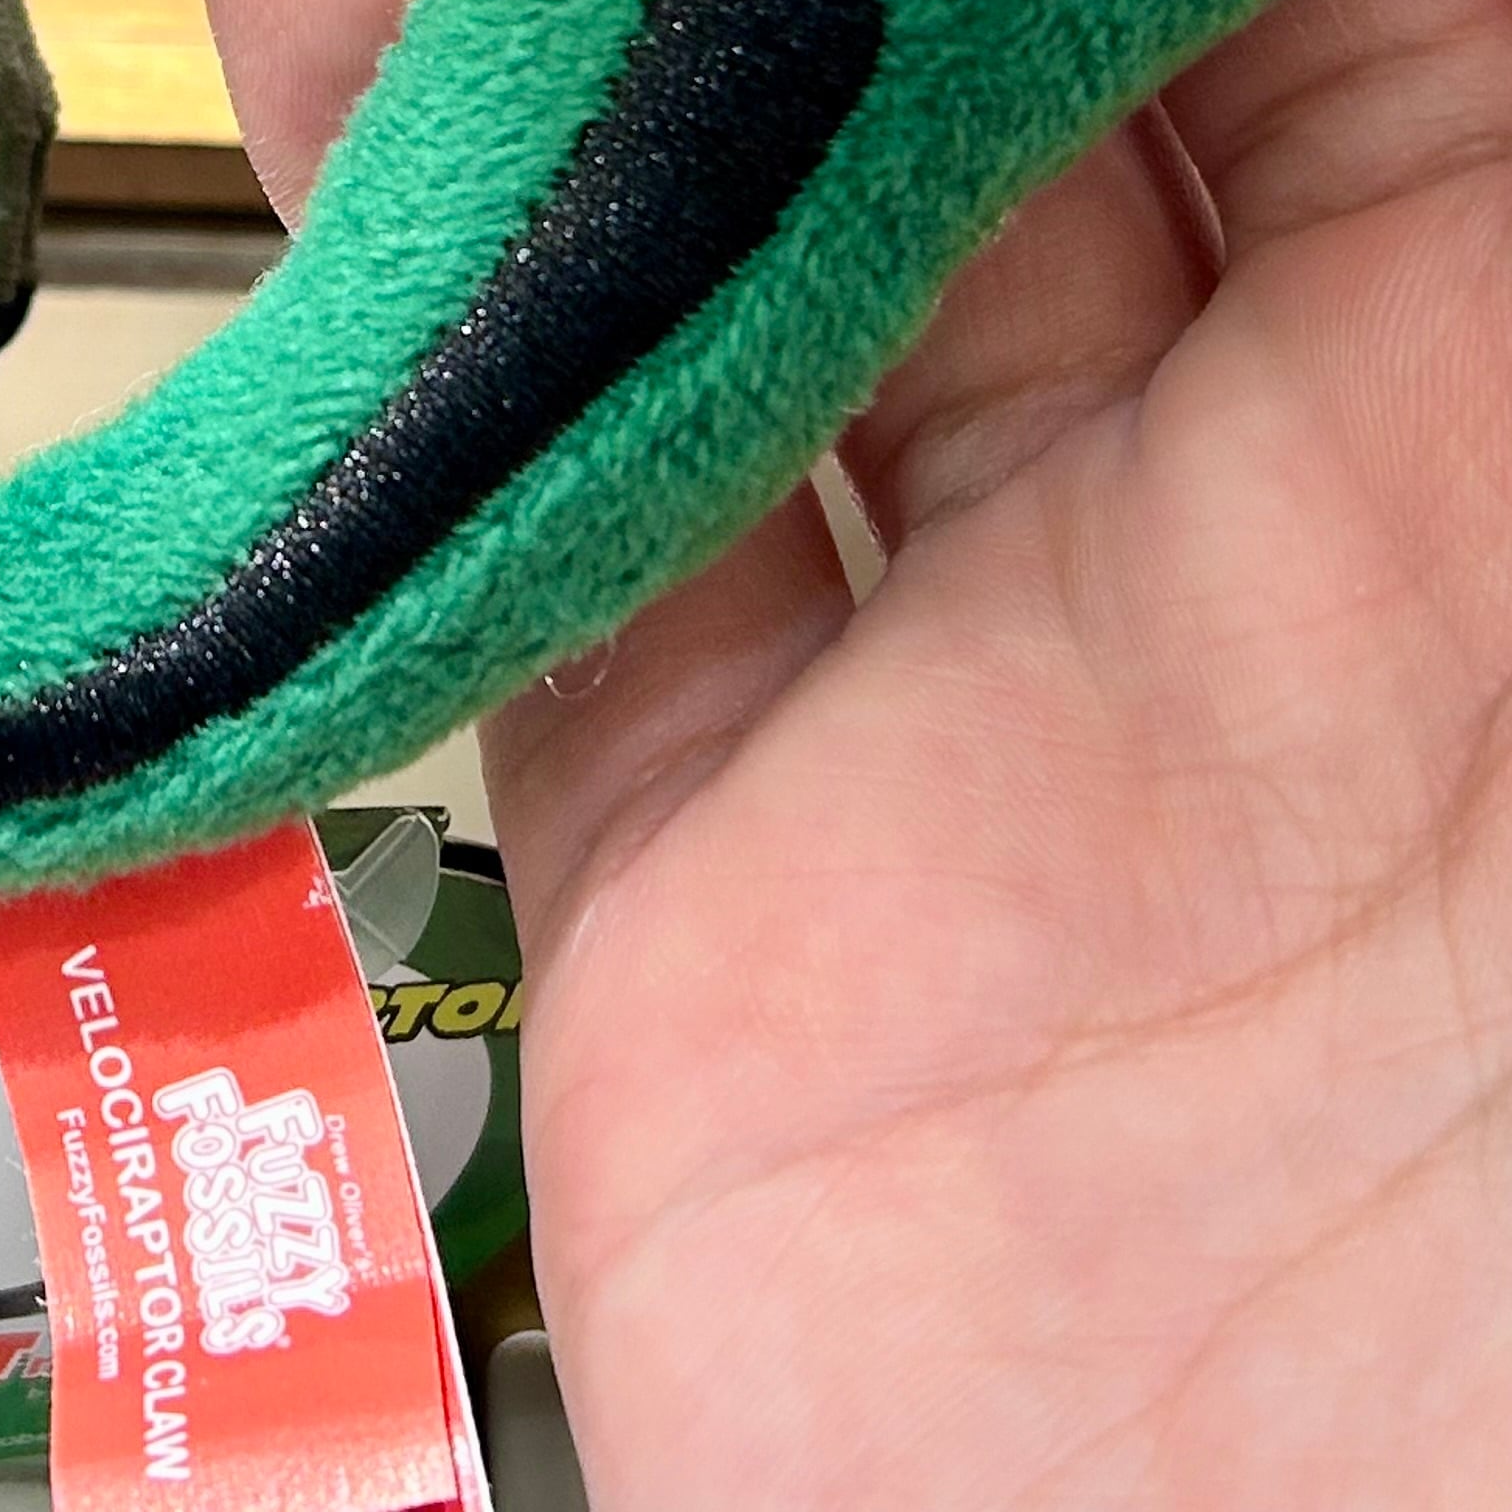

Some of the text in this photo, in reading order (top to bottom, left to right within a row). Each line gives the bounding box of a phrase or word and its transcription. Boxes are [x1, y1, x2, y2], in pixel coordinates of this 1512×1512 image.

[56, 1107, 120, 1380] FuzzyFossils.com
[61, 944, 190, 1481] VELOCIRAPTOR CLAW
[152, 1066, 286, 1354] FOSSILS
[324, 1114, 350, 1176] Drew
